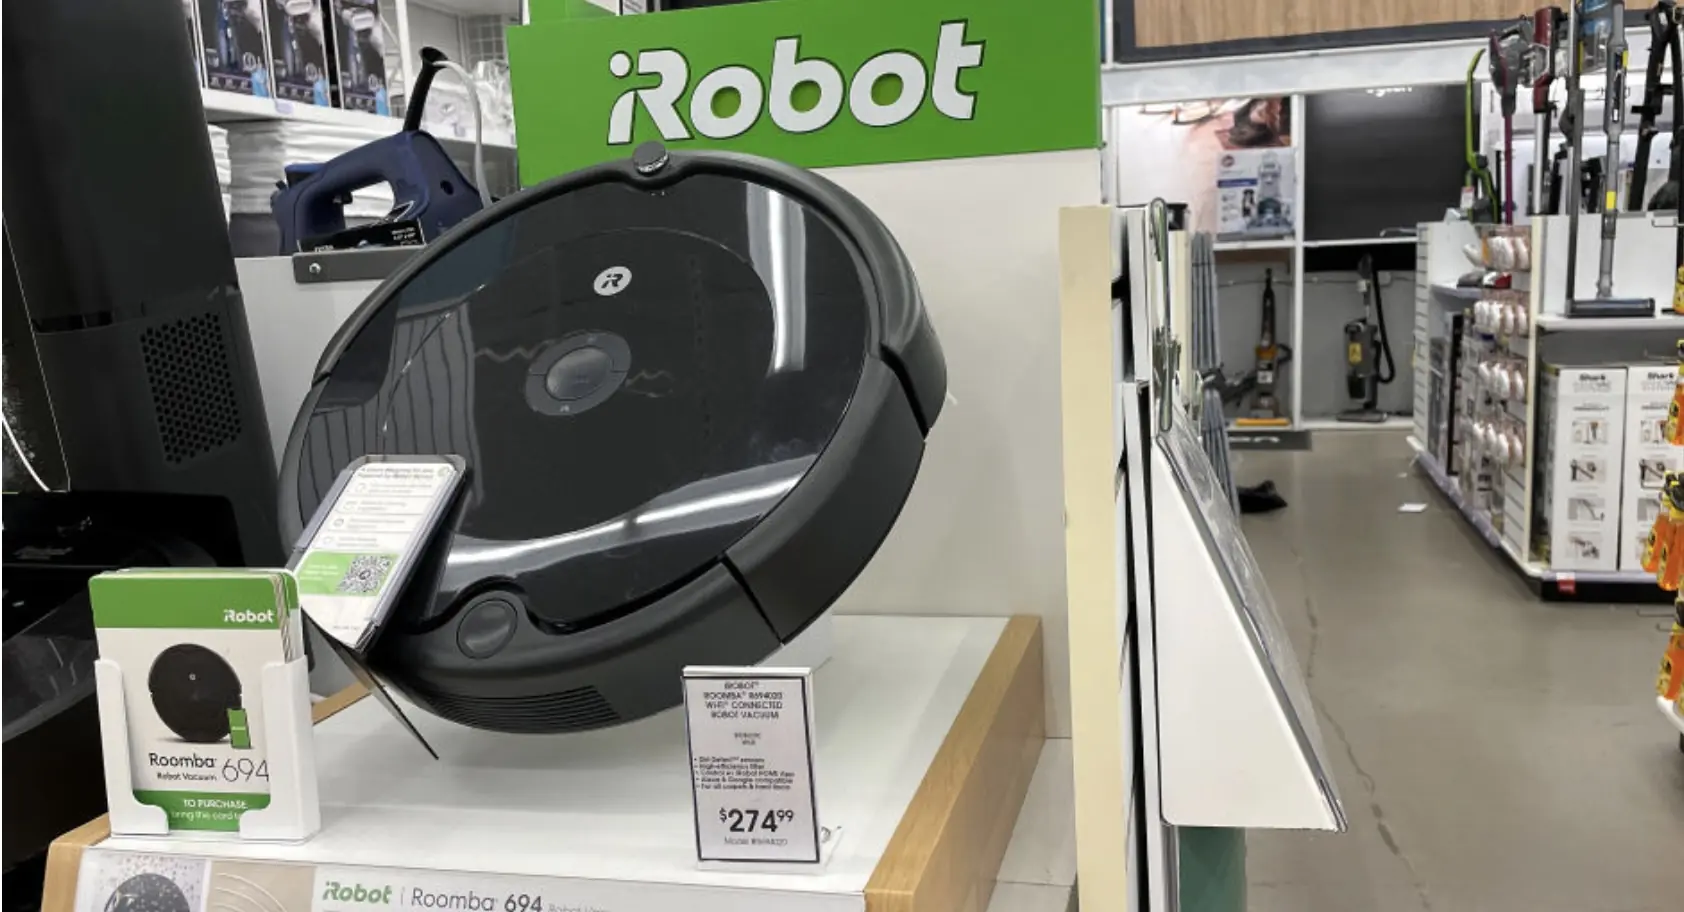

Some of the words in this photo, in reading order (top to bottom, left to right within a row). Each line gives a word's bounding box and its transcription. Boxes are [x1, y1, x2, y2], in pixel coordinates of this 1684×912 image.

[607, 19, 986, 145] iRobot
[223, 609, 275, 623] iRobot
[731, 701, 783, 709] CONNECTED
[711, 711, 738, 719] ROBOT
[741, 711, 780, 719] VACUUM
[222, 758, 269, 782] 694
[157, 772, 181, 780] Robot
[182, 772, 217, 781] Vacuum
[183, 799, 196, 808] TO
[198, 799, 248, 809] PURCHASE
[322, 881, 393, 904] iRobot
[504, 893, 542, 912] 694
